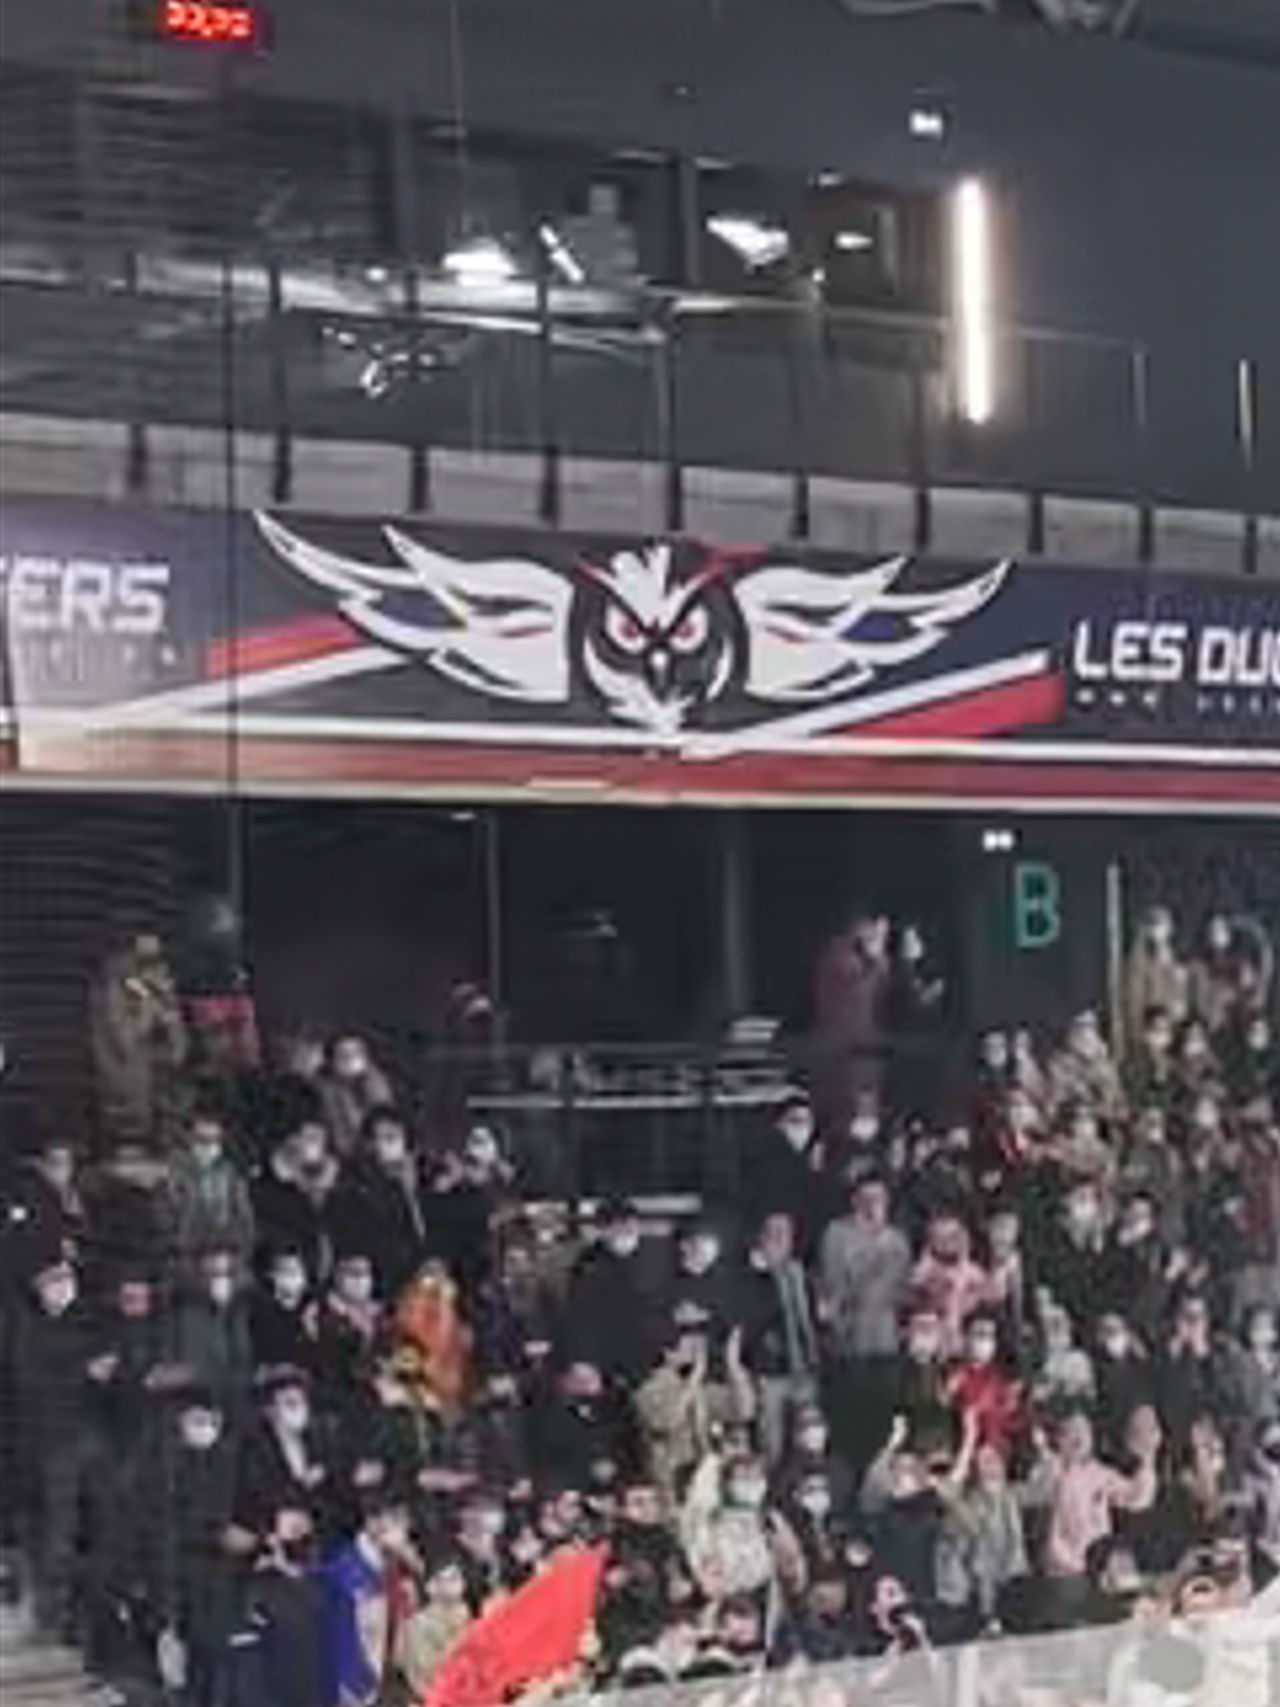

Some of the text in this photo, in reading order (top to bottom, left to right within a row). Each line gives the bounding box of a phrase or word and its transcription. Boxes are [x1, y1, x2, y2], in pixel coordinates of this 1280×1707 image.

[0, 555, 170, 635] ERS
[1072, 619, 1187, 682] LES
[1015, 860, 1061, 948] B
